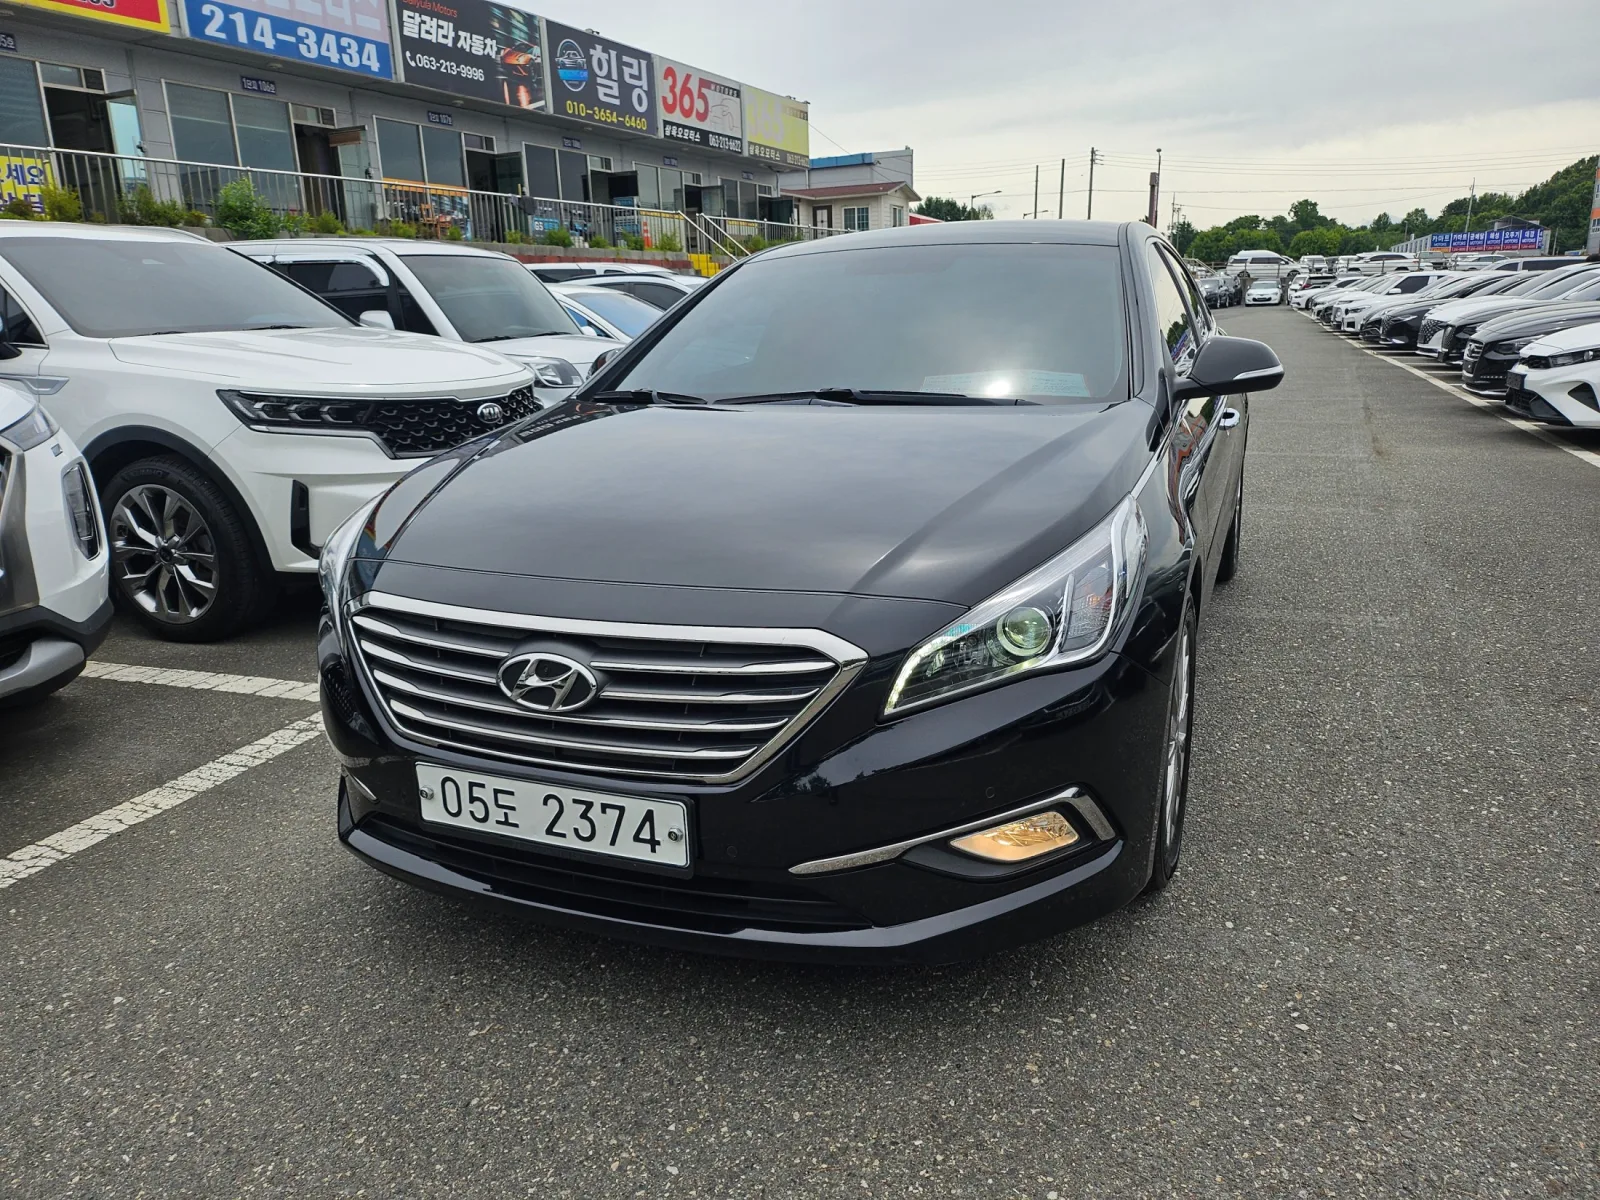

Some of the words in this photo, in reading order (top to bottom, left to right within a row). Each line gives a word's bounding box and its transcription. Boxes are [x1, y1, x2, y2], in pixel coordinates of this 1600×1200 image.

[402, 9, 455, 48] 달려라
[457, 30, 497, 59] 자동차
[432, 2, 458, 18] Motors
[201, 4, 381, 73] 214-3434
[415, 53, 485, 81] 063-213-9996
[589, 43, 648, 113] 힐링
[565, 100, 648, 130] 010-3654-6460
[661, 66, 710, 123] 365
[664, 124, 701, 142] 삼육오모터스
[440, 775, 520, 829] 05도
[542, 793, 661, 854] 2374
